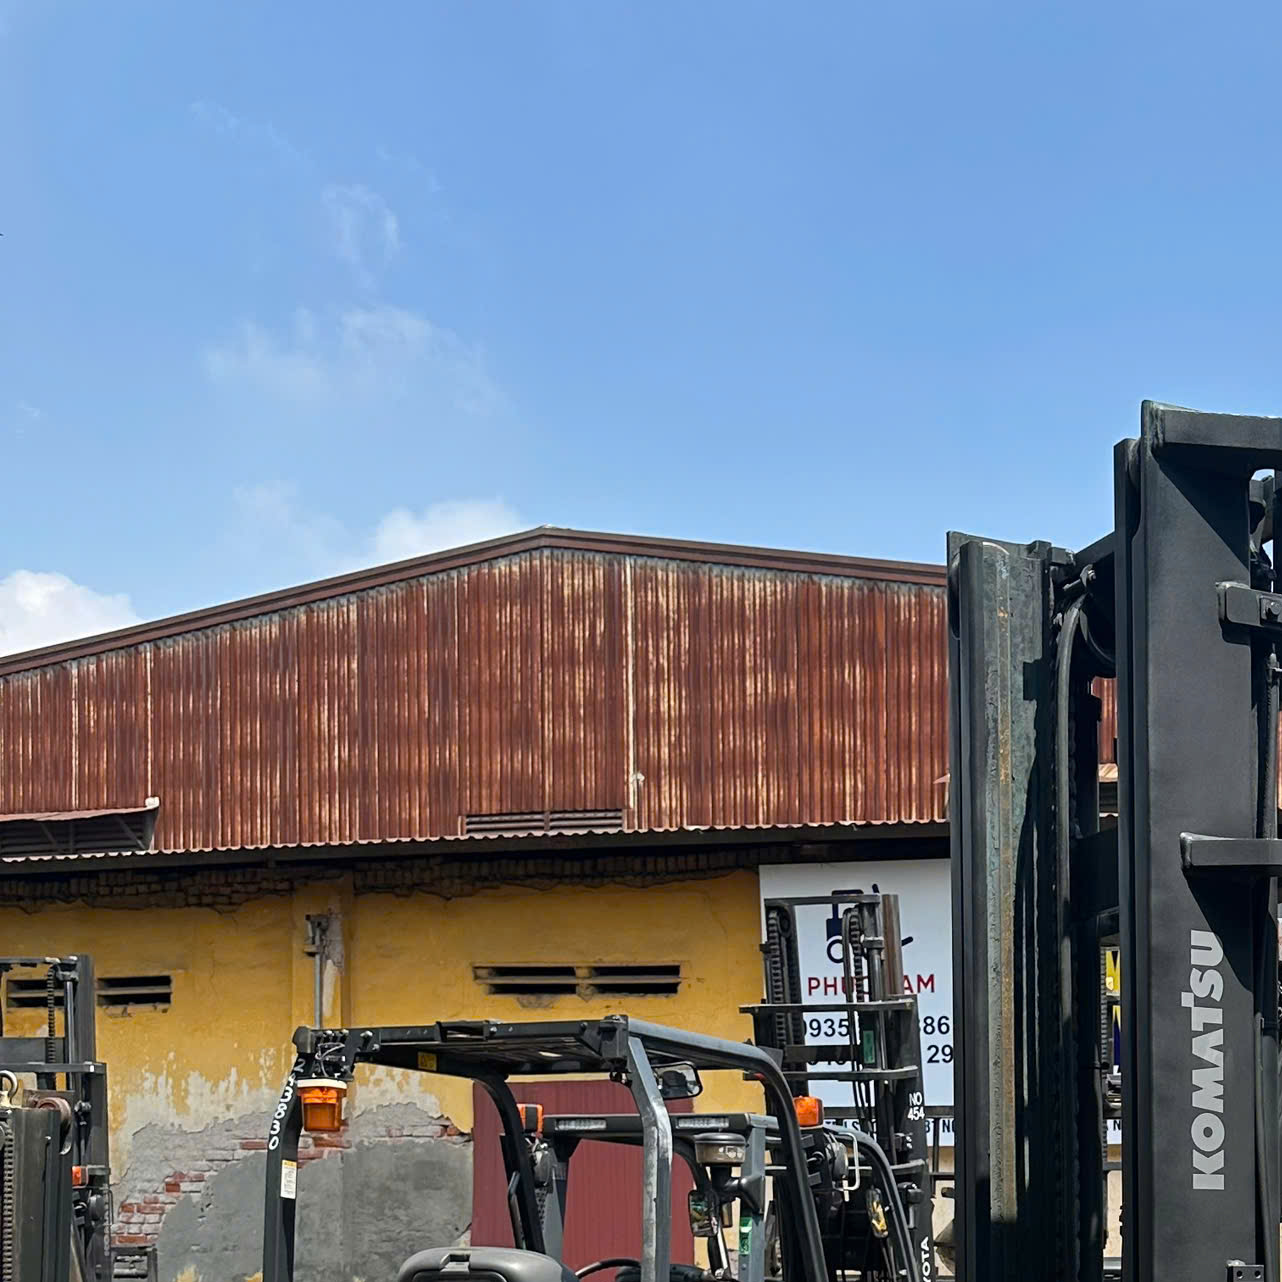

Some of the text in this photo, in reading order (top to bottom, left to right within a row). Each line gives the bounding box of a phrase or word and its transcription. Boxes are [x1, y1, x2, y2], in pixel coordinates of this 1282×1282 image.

[1181, 929, 1225, 1190] KOMATSU
[909, 1091, 923, 1106] NO
[907, 1106, 925, 1120] 454
